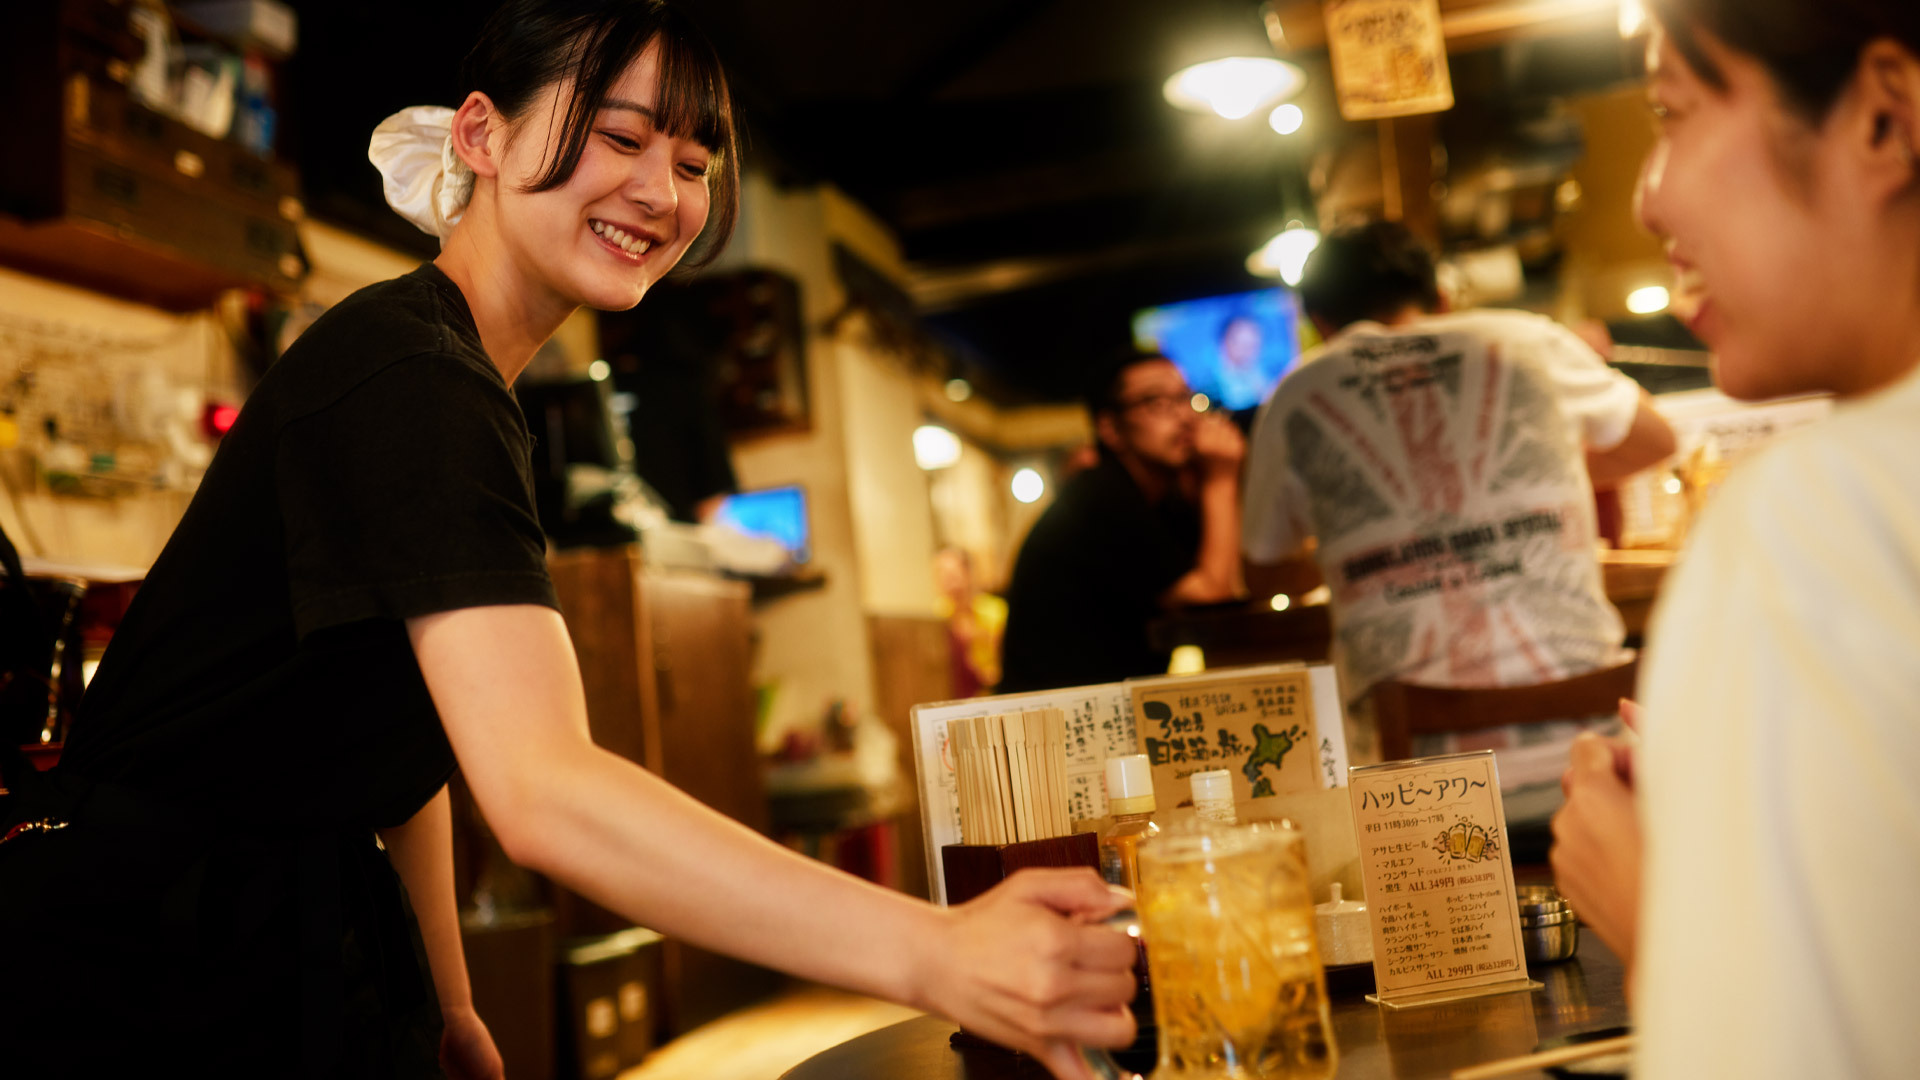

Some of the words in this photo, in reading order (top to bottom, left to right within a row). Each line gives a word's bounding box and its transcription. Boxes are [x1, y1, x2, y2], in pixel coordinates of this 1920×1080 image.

[1372, 840, 1429, 857] アサヒ生ビール
[1407, 881, 1427, 893] ALL
[1429, 877, 1455, 890] 349円
[1379, 901, 1414, 913] ハイボール
[1448, 900, 1488, 914] ウーロンハイ
[1450, 910, 1496, 925] ジャスミンハイ
[1451, 922, 1484, 935] そば茶ハイ
[1384, 930, 1446, 945] クランベリーサワー
[1452, 934, 1473, 945] 日本酒
[1386, 942, 1433, 956] クエン酸サワー
[1388, 950, 1449, 966] シークワーサーサワー
[1426, 968, 1446, 980] ALL
[1447, 964, 1474, 977] 299円
